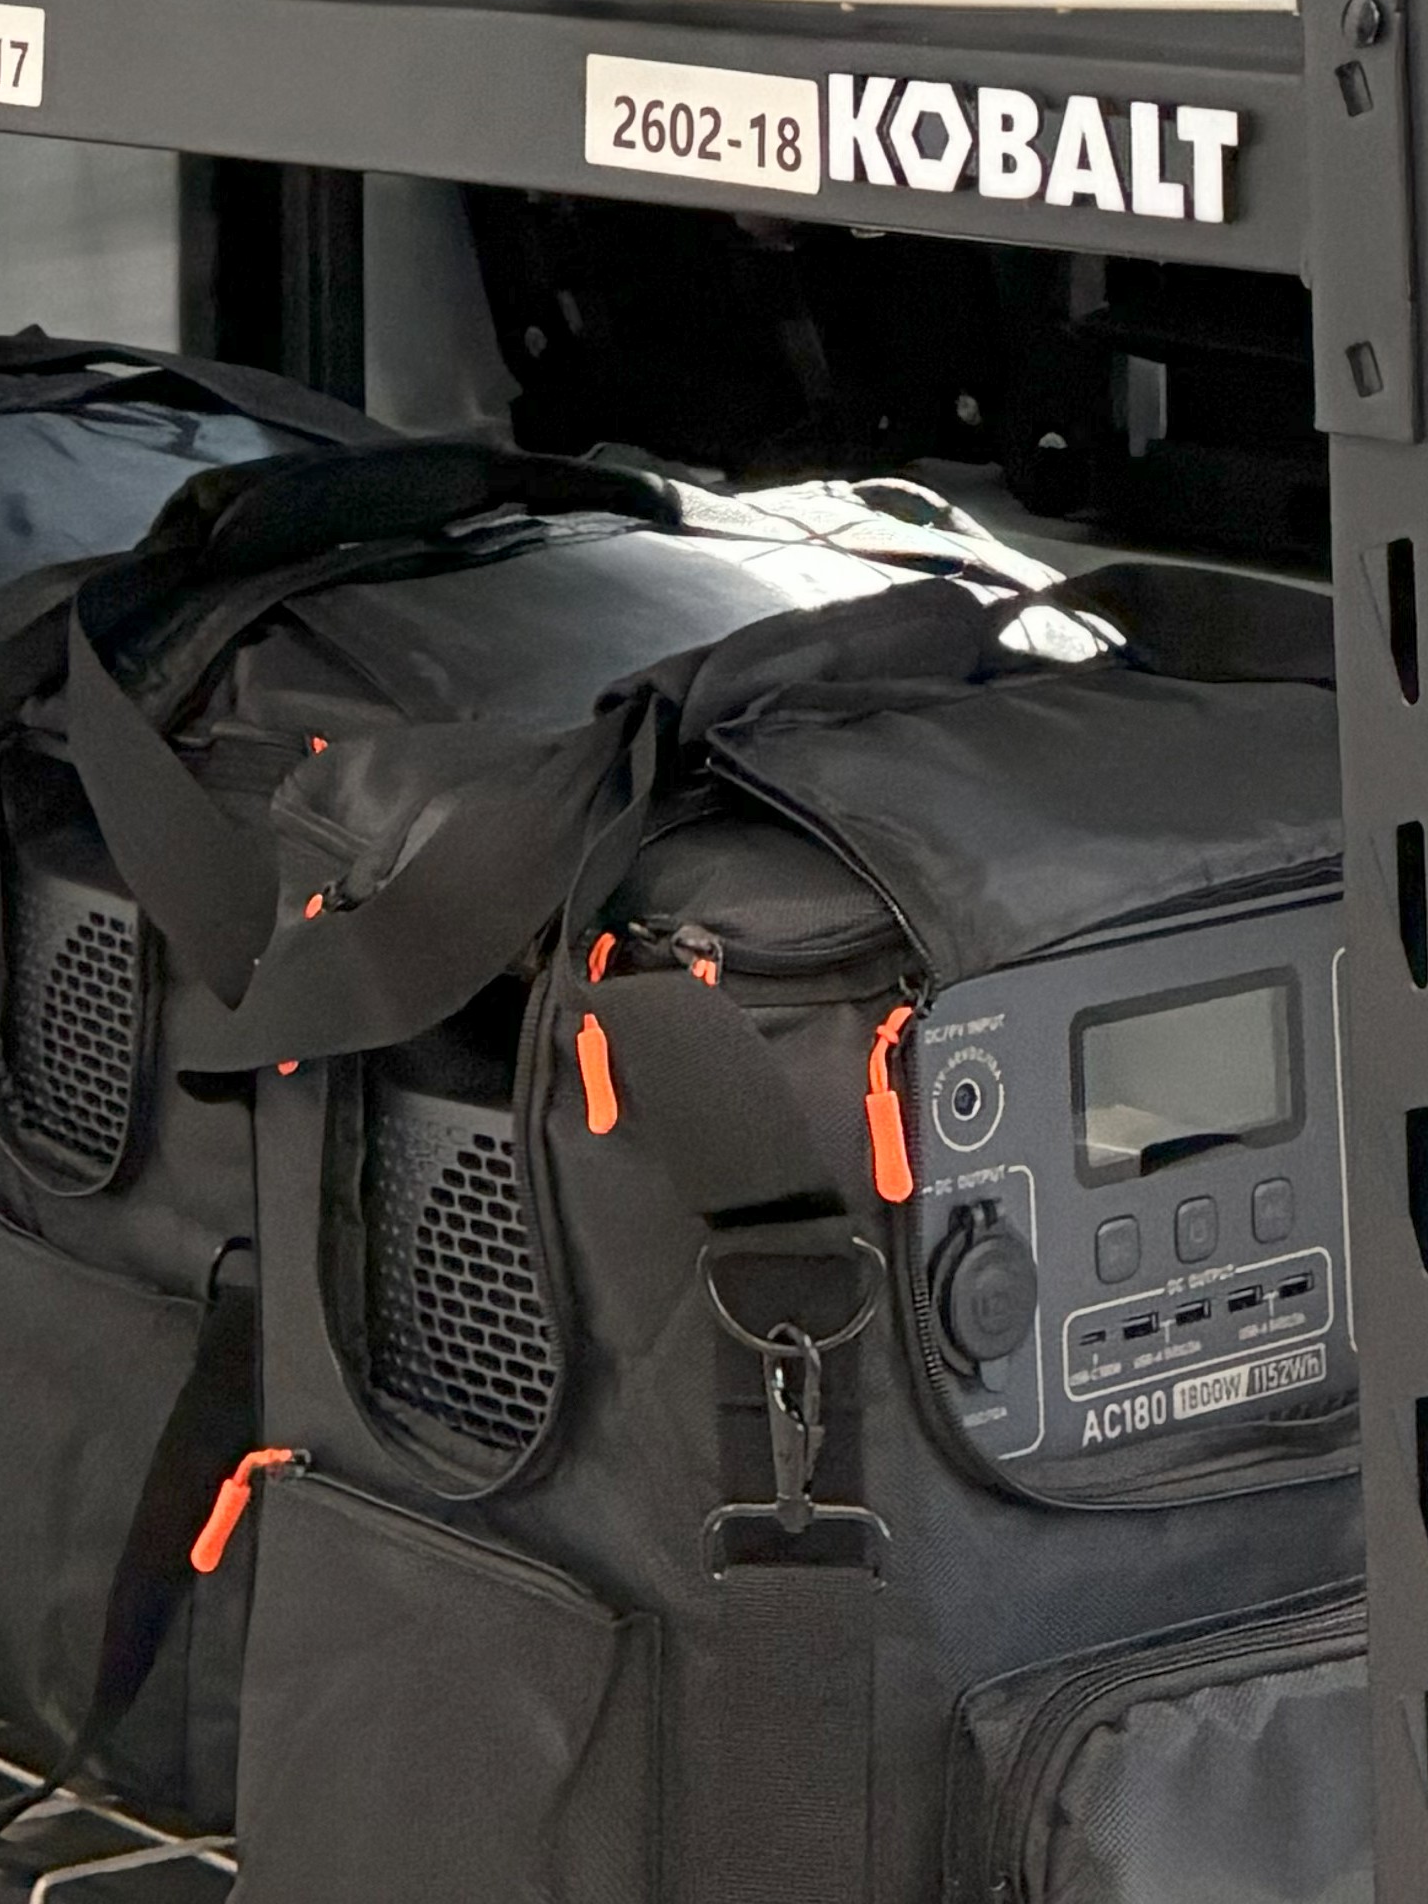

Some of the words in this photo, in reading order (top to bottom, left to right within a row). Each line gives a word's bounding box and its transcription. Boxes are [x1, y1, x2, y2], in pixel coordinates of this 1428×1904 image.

[612, 94, 803, 172] 2602-18
[828, 72, 1238, 223] KOBALT
[1081, 1390, 1167, 1448] AC180
[1179, 1373, 1242, 1413] 1800W
[1252, 1355, 1321, 1389] 1152Wh
